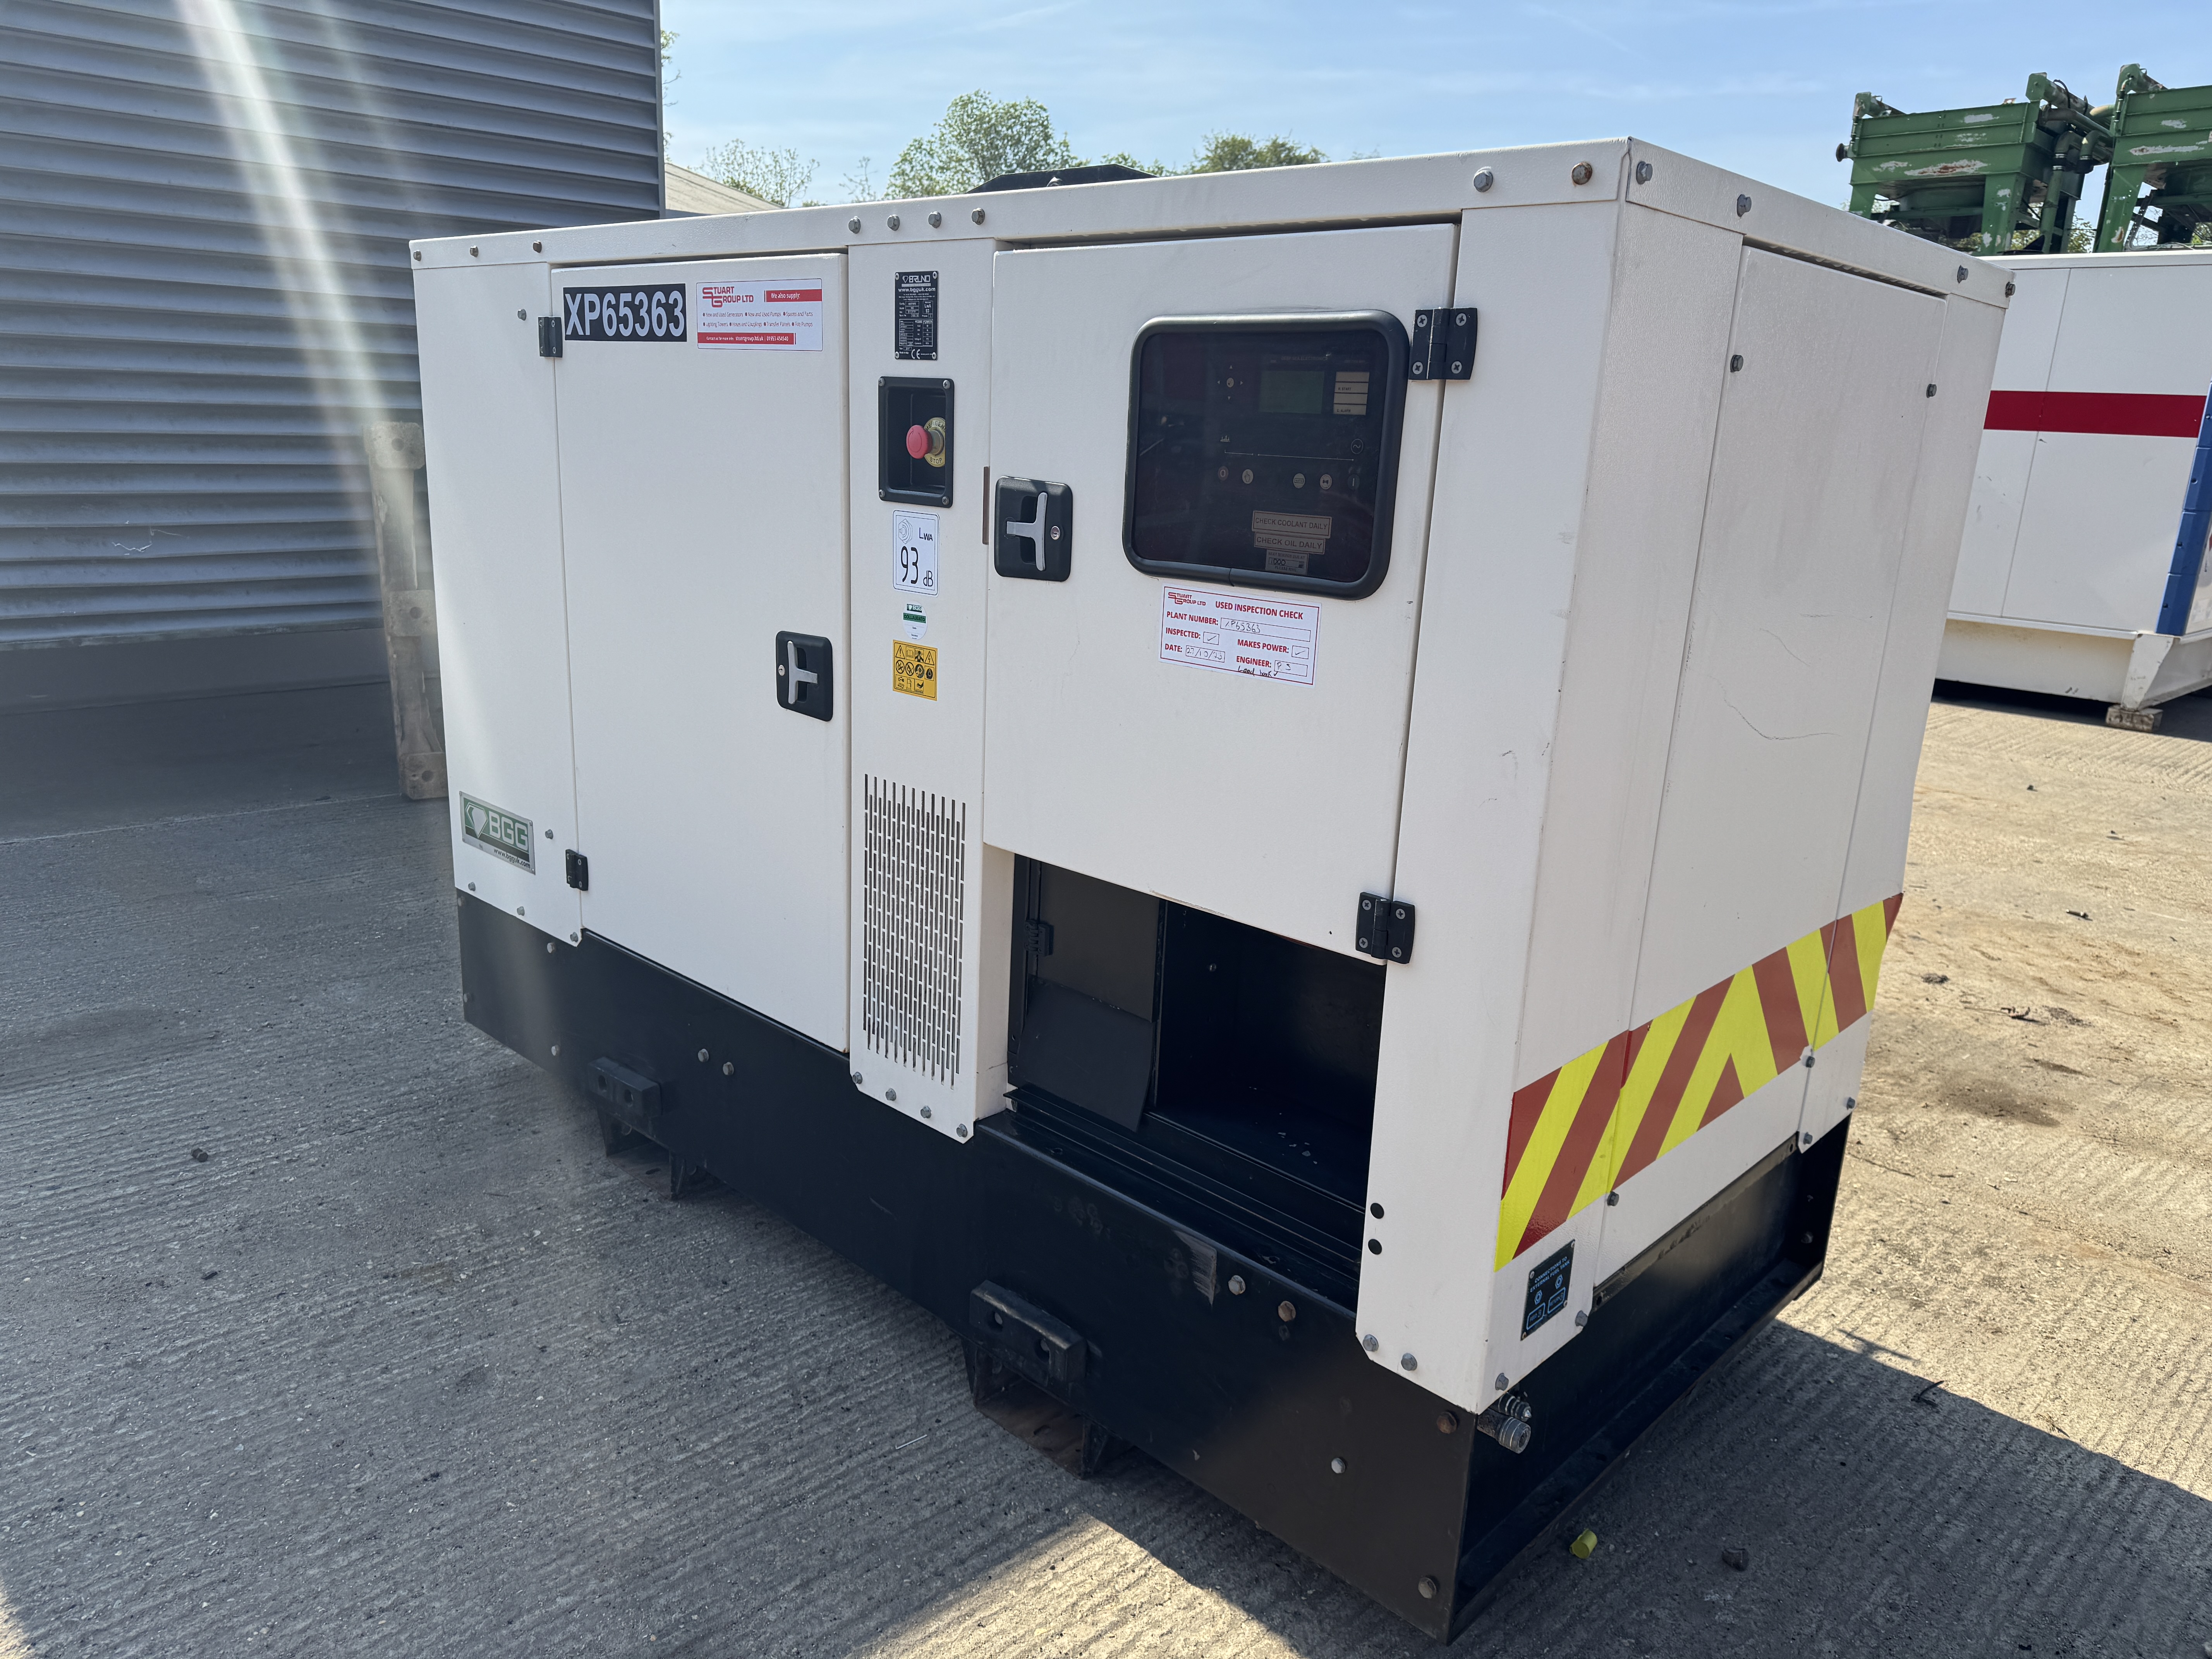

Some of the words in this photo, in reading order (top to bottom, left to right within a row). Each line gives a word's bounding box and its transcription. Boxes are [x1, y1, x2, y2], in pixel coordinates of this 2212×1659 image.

[702, 287, 734, 297] STUART
[712, 295, 740, 307] GROUP
[565, 290, 685, 337] XP65363
[1278, 519, 1307, 528] COOLANT
[1257, 537, 1282, 545] CHECK
[901, 546, 918, 584] 93
[923, 570, 933, 587] dB
[1215, 601, 1233, 610] USED
[1234, 604, 1277, 616] INSPECTION
[1279, 610, 1303, 620] CHECK
[1167, 611, 1187, 620] PLANT
[1188, 614, 1218, 625] NUMBER:
[1166, 627, 1200, 639] INSPECTED:
[1165, 643, 1182, 653] DATE:
[1237, 639, 1261, 649] MAKES
[1262, 643, 1289, 653] POWER:
[1236, 656, 1271, 668] ENGINEER:
[489, 811, 528, 851] BGG
[494, 848, 530, 869] www.bgguk.com
[1530, 1275, 1549, 1292] EXTERNAL
[1550, 1267, 1559, 1277] FUEL
[1560, 1259, 1570, 1270] TANK
[1535, 1260, 1561, 1283] CONNECTIONS
